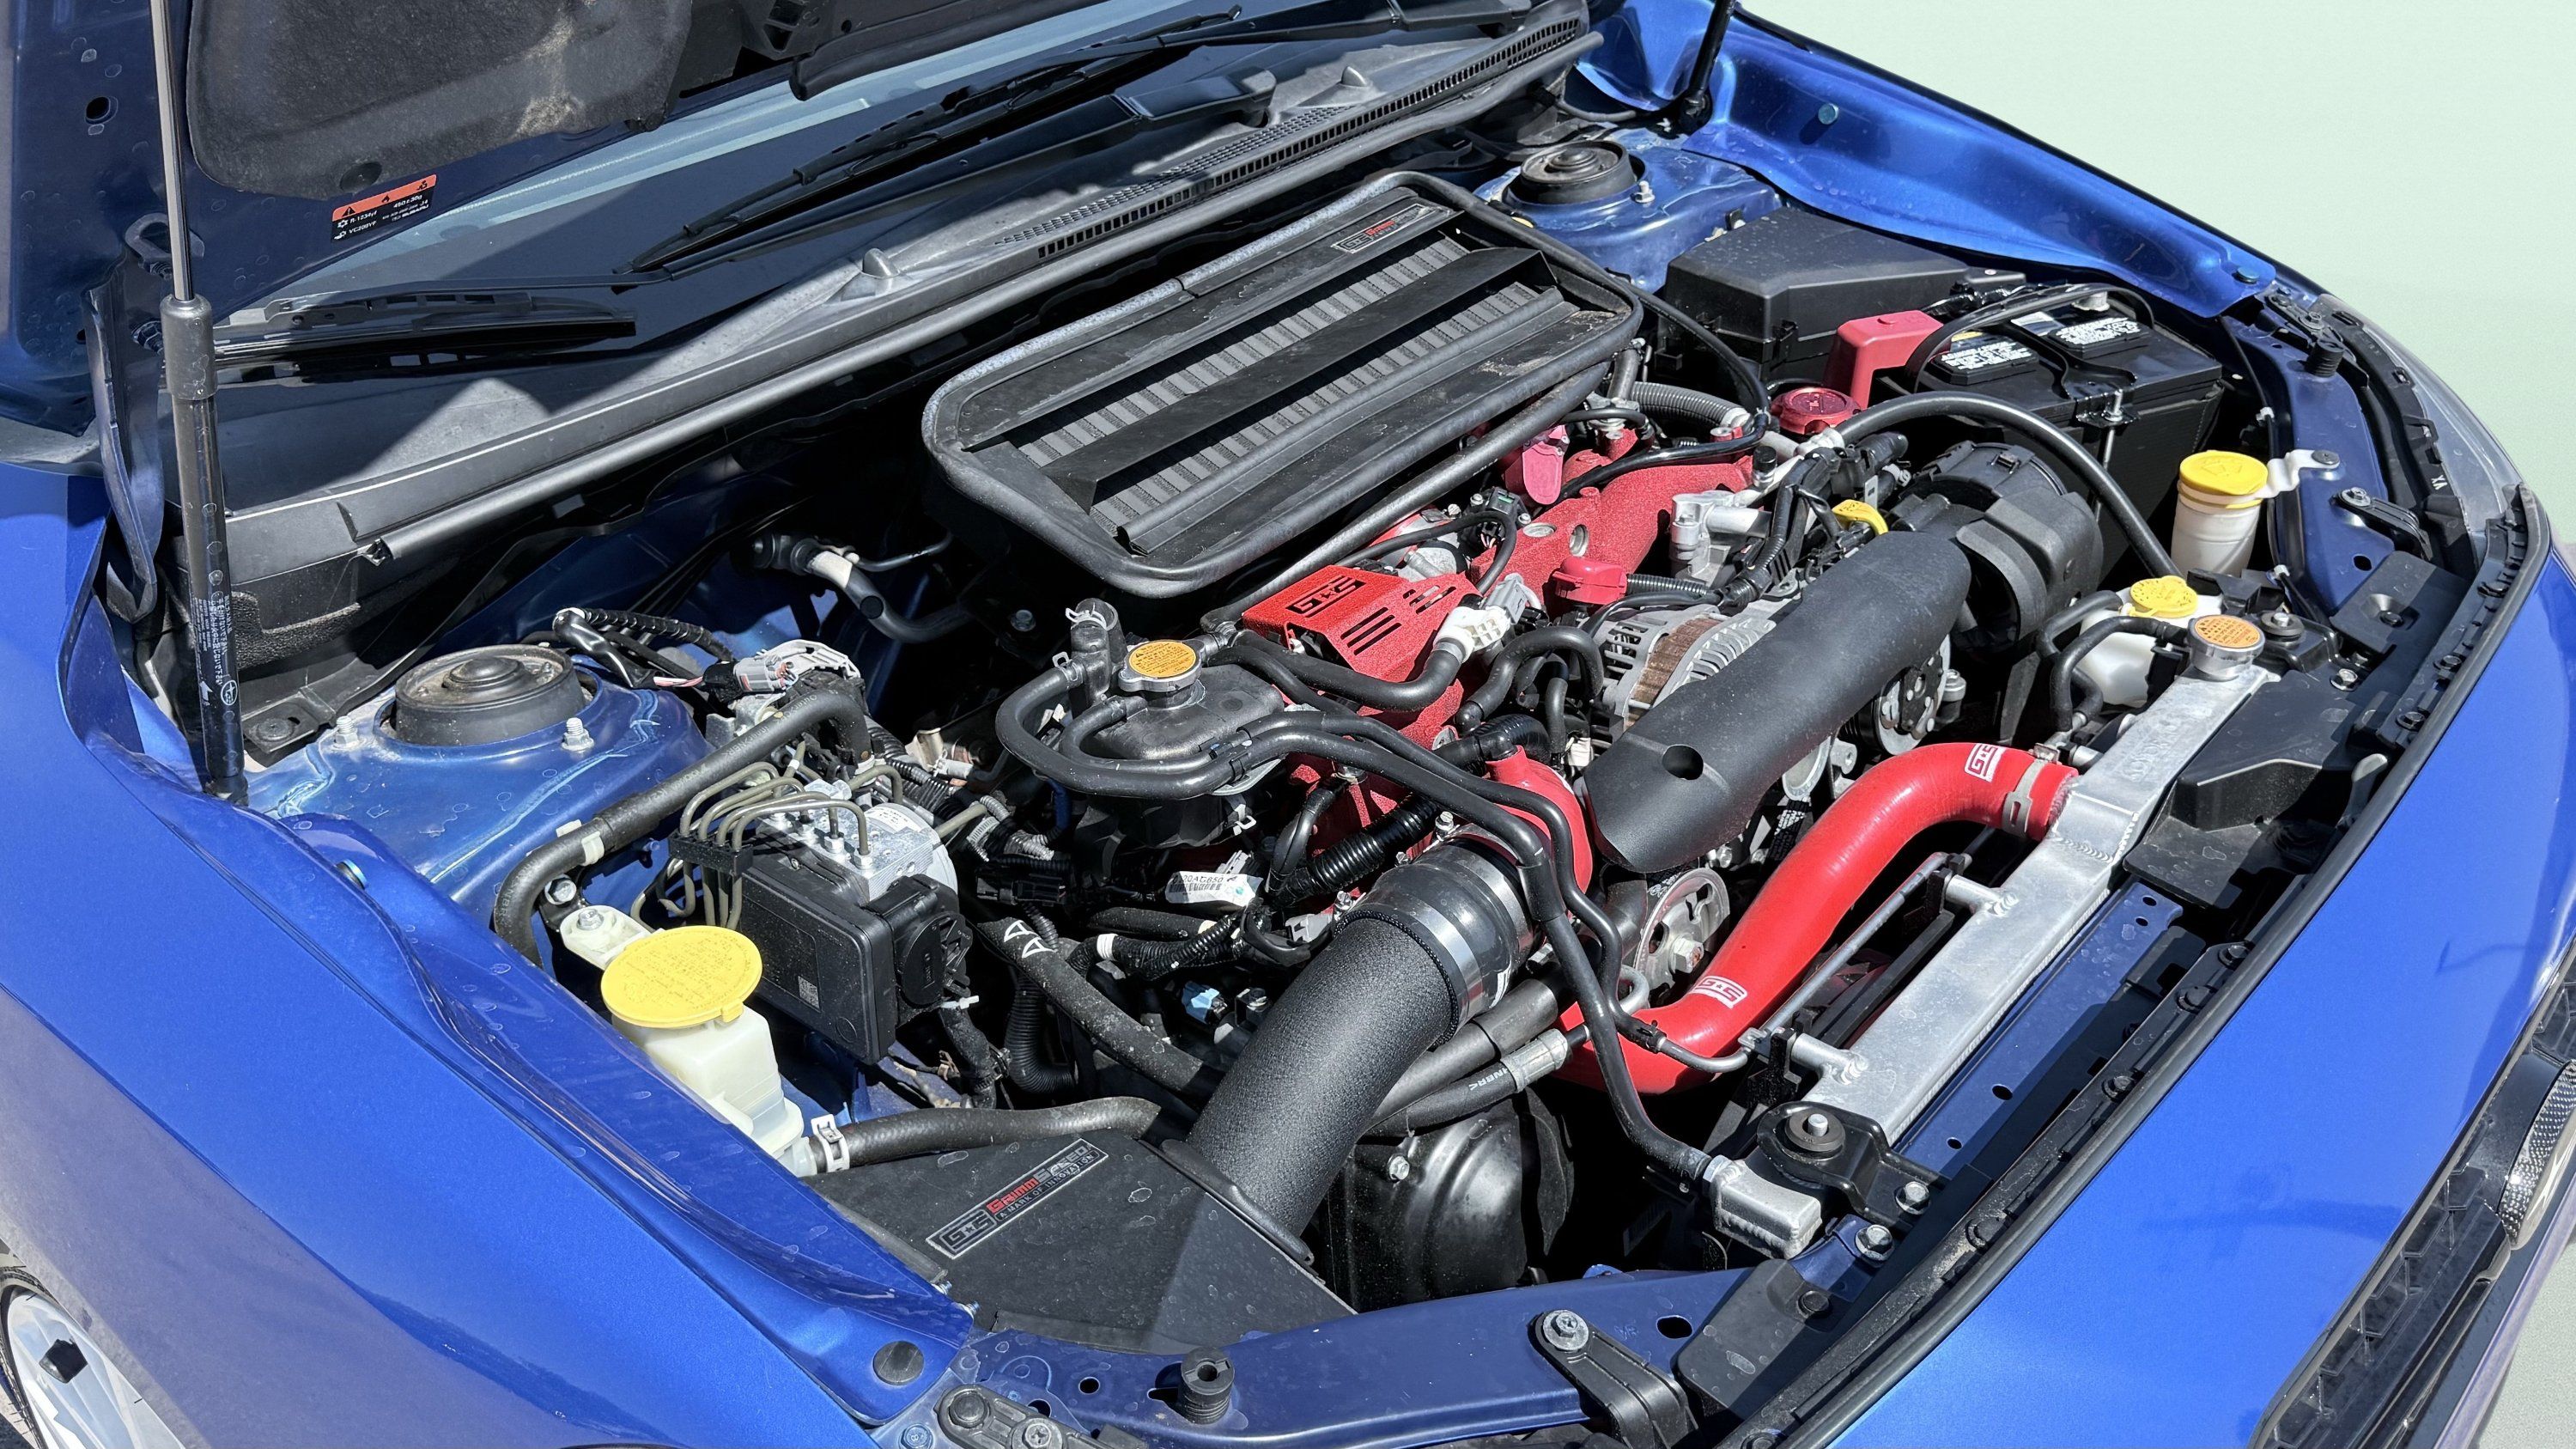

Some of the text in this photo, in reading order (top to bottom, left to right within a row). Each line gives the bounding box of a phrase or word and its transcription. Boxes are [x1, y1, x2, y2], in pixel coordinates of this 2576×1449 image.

[1007, 1195, 1032, 1212] MARK
[1032, 1186, 1042, 1196] OF
[1045, 1154, 1095, 1188] INNOVATION
